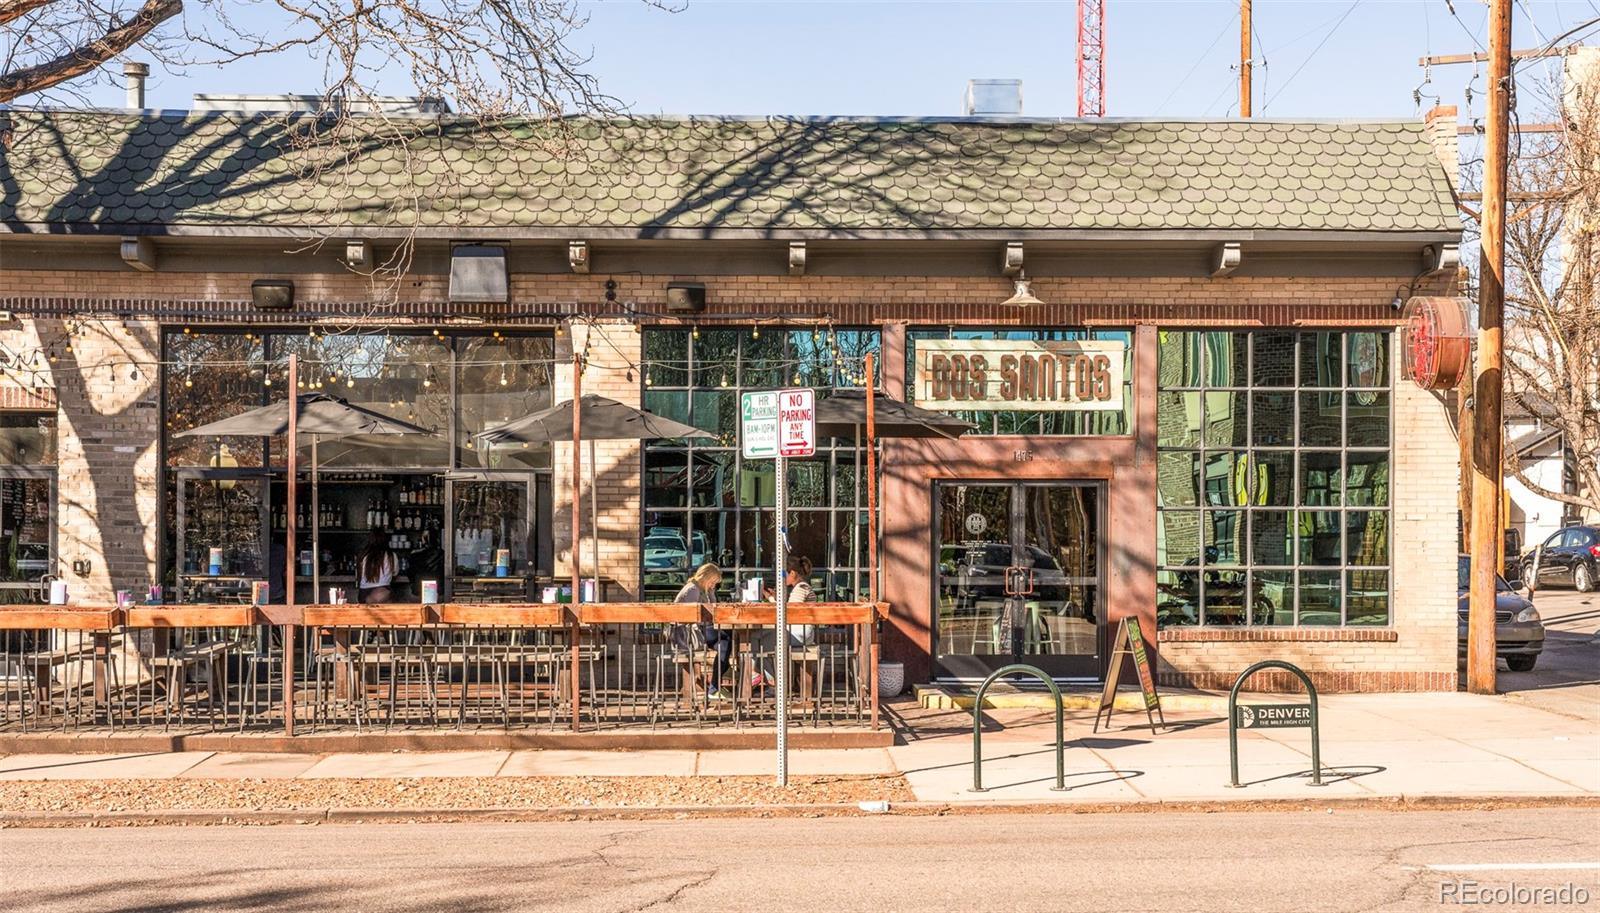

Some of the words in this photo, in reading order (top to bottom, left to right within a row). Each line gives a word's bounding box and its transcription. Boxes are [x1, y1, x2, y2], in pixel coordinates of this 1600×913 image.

[1000, 354, 1112, 400] SANTOS
[758, 396, 769, 406] HR
[789, 394, 803, 407] NO
[743, 399, 751, 416] 2
[752, 406, 777, 417] PARKING
[781, 408, 812, 422] PARKING
[790, 422, 803, 430] ANY
[789, 431, 804, 439] TIME
[1258, 708, 1310, 719] DENVER
